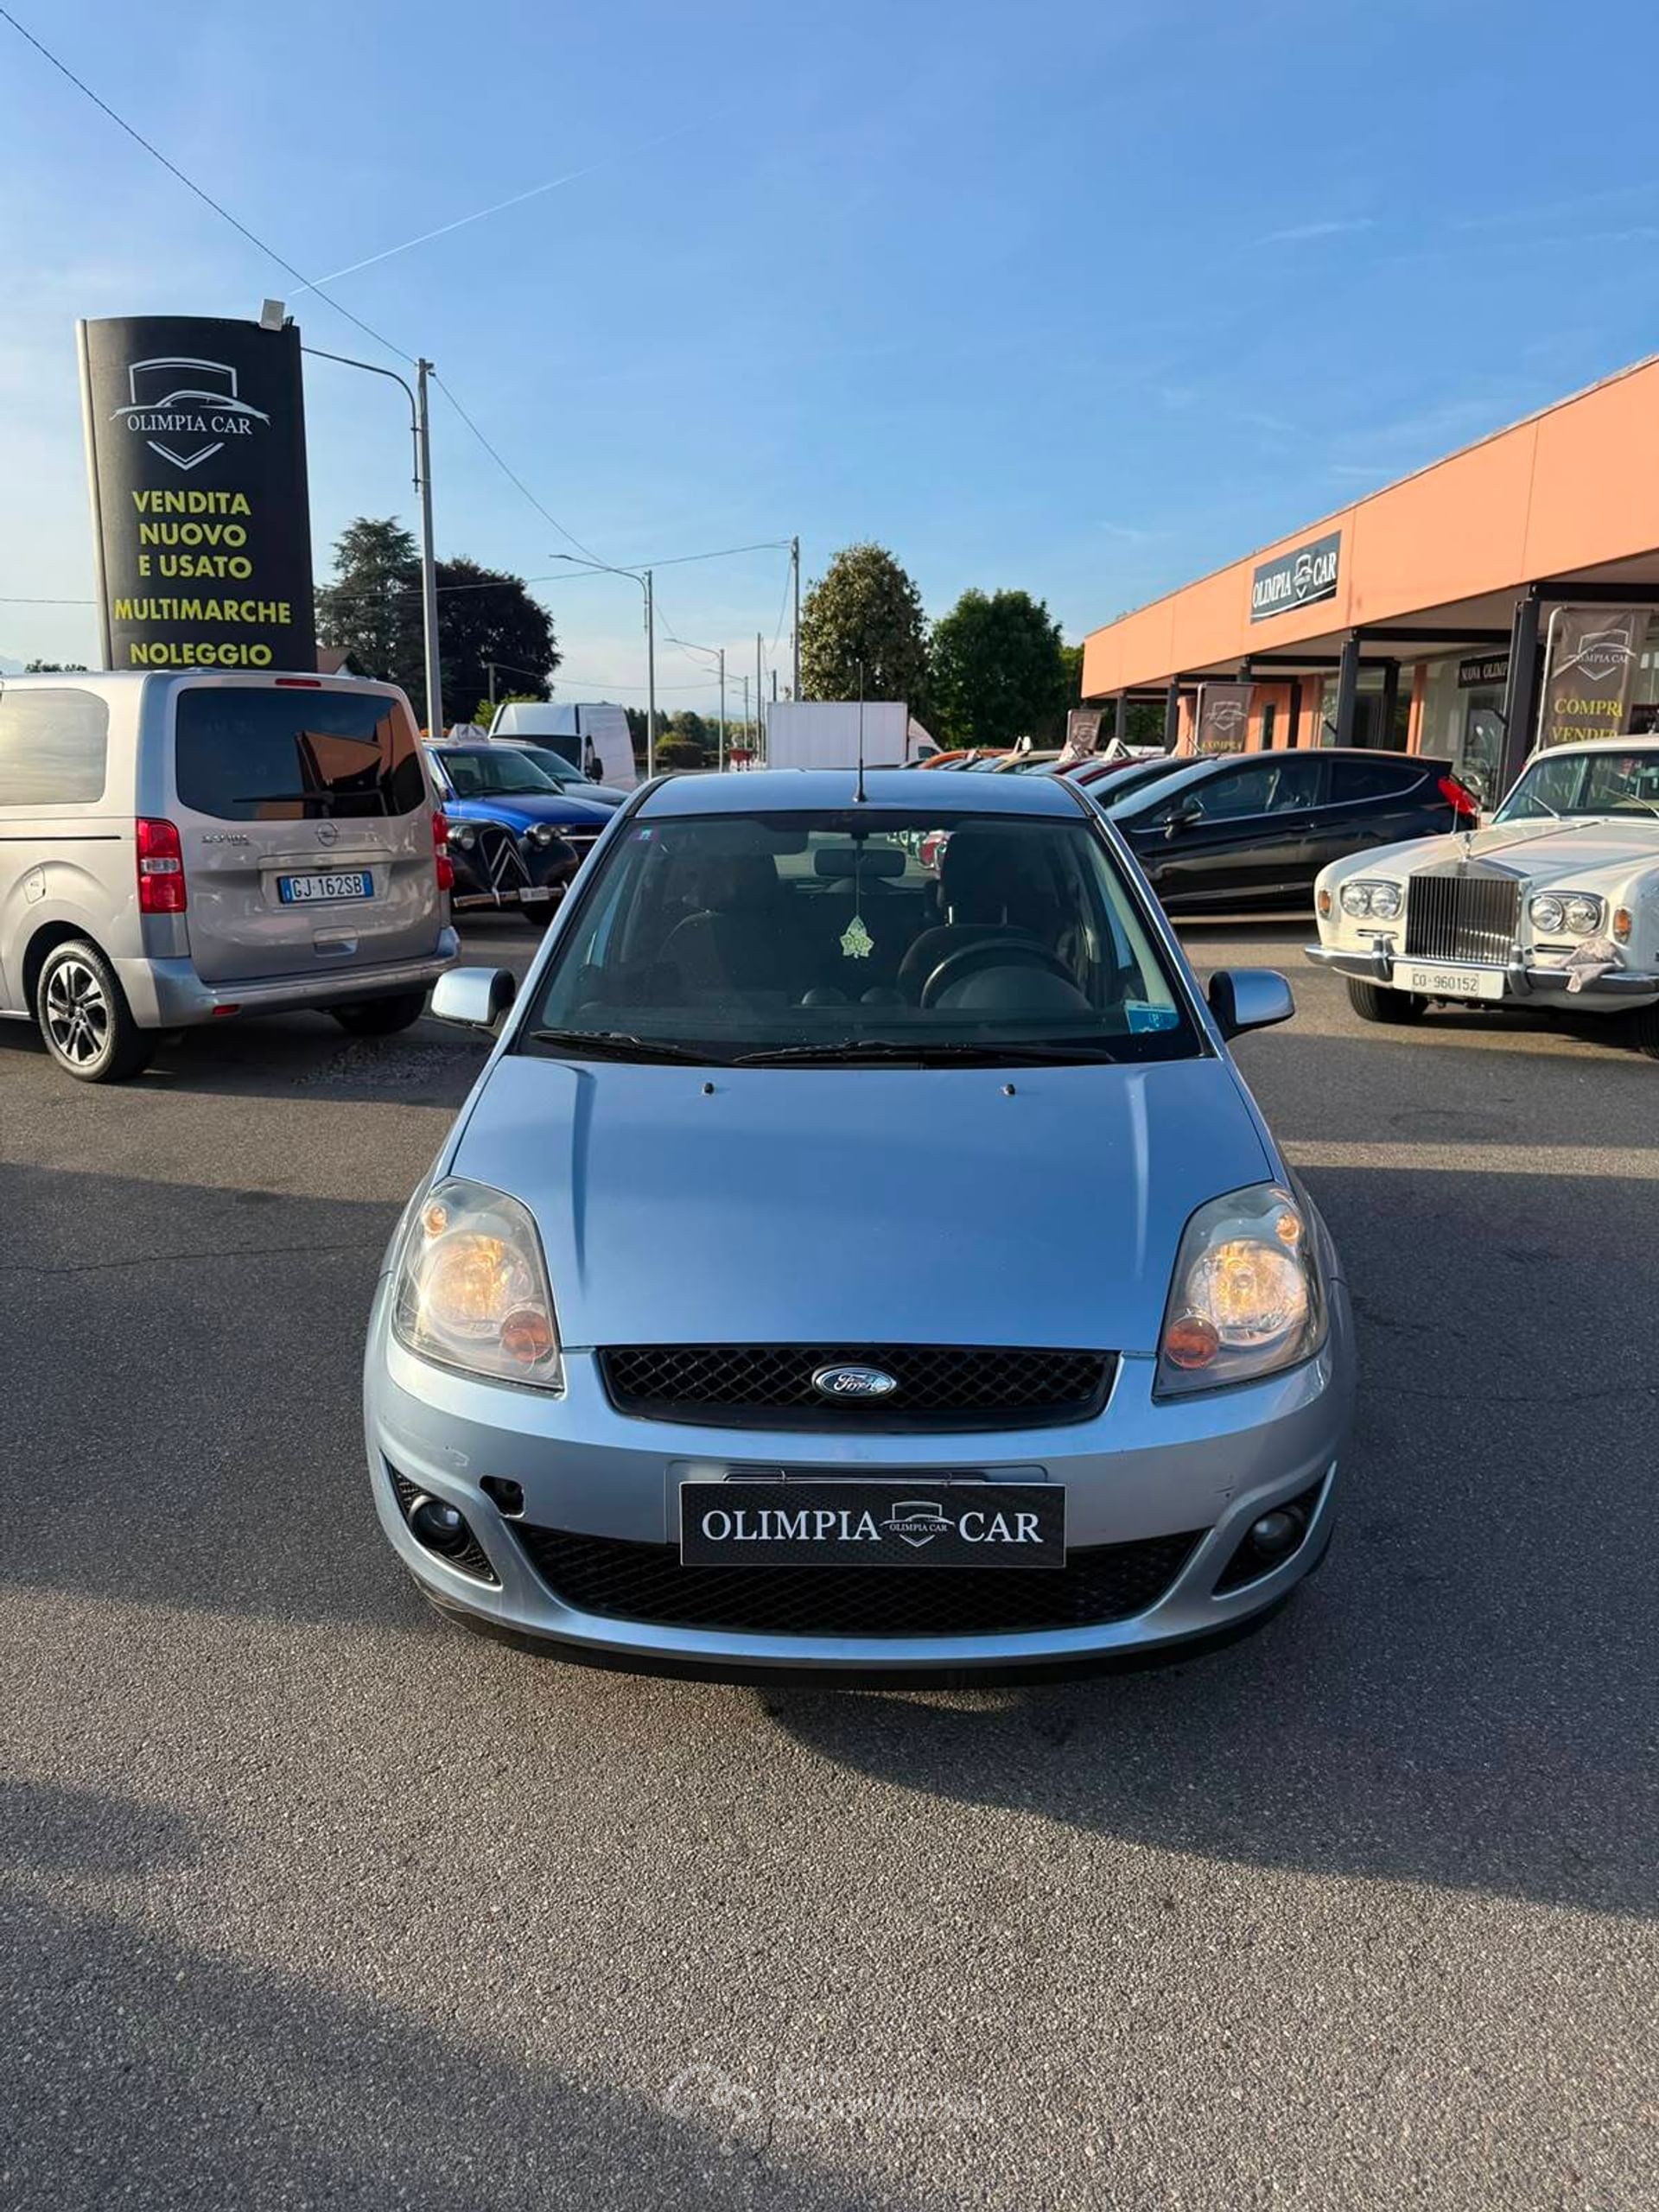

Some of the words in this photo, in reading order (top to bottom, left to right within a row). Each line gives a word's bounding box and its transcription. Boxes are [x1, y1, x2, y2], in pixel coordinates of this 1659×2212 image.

[127, 414, 207, 432] OLIMPIA
[211, 416, 253, 435] CAR
[132, 491, 251, 516] VENDITA
[139, 523, 247, 548] NUOVO
[138, 555, 151, 576] E
[159, 554, 252, 579] USATO
[1252, 570, 1292, 608] OLIMPIA
[1313, 551, 1337, 586] CAR
[114, 598, 292, 625] MULTIMARCHE
[130, 642, 273, 666] NOLEGGIO
[292, 878, 311, 898] GJ
[318, 875, 362, 896] 162SB
[833, 1371, 876, 1392] Ford
[701, 1509, 882, 1541] OLIMPIA
[958, 1511, 1043, 1543] CAR
[888, 1523, 928, 1532] OLIMPIA
[929, 1523, 948, 1532] CAR
